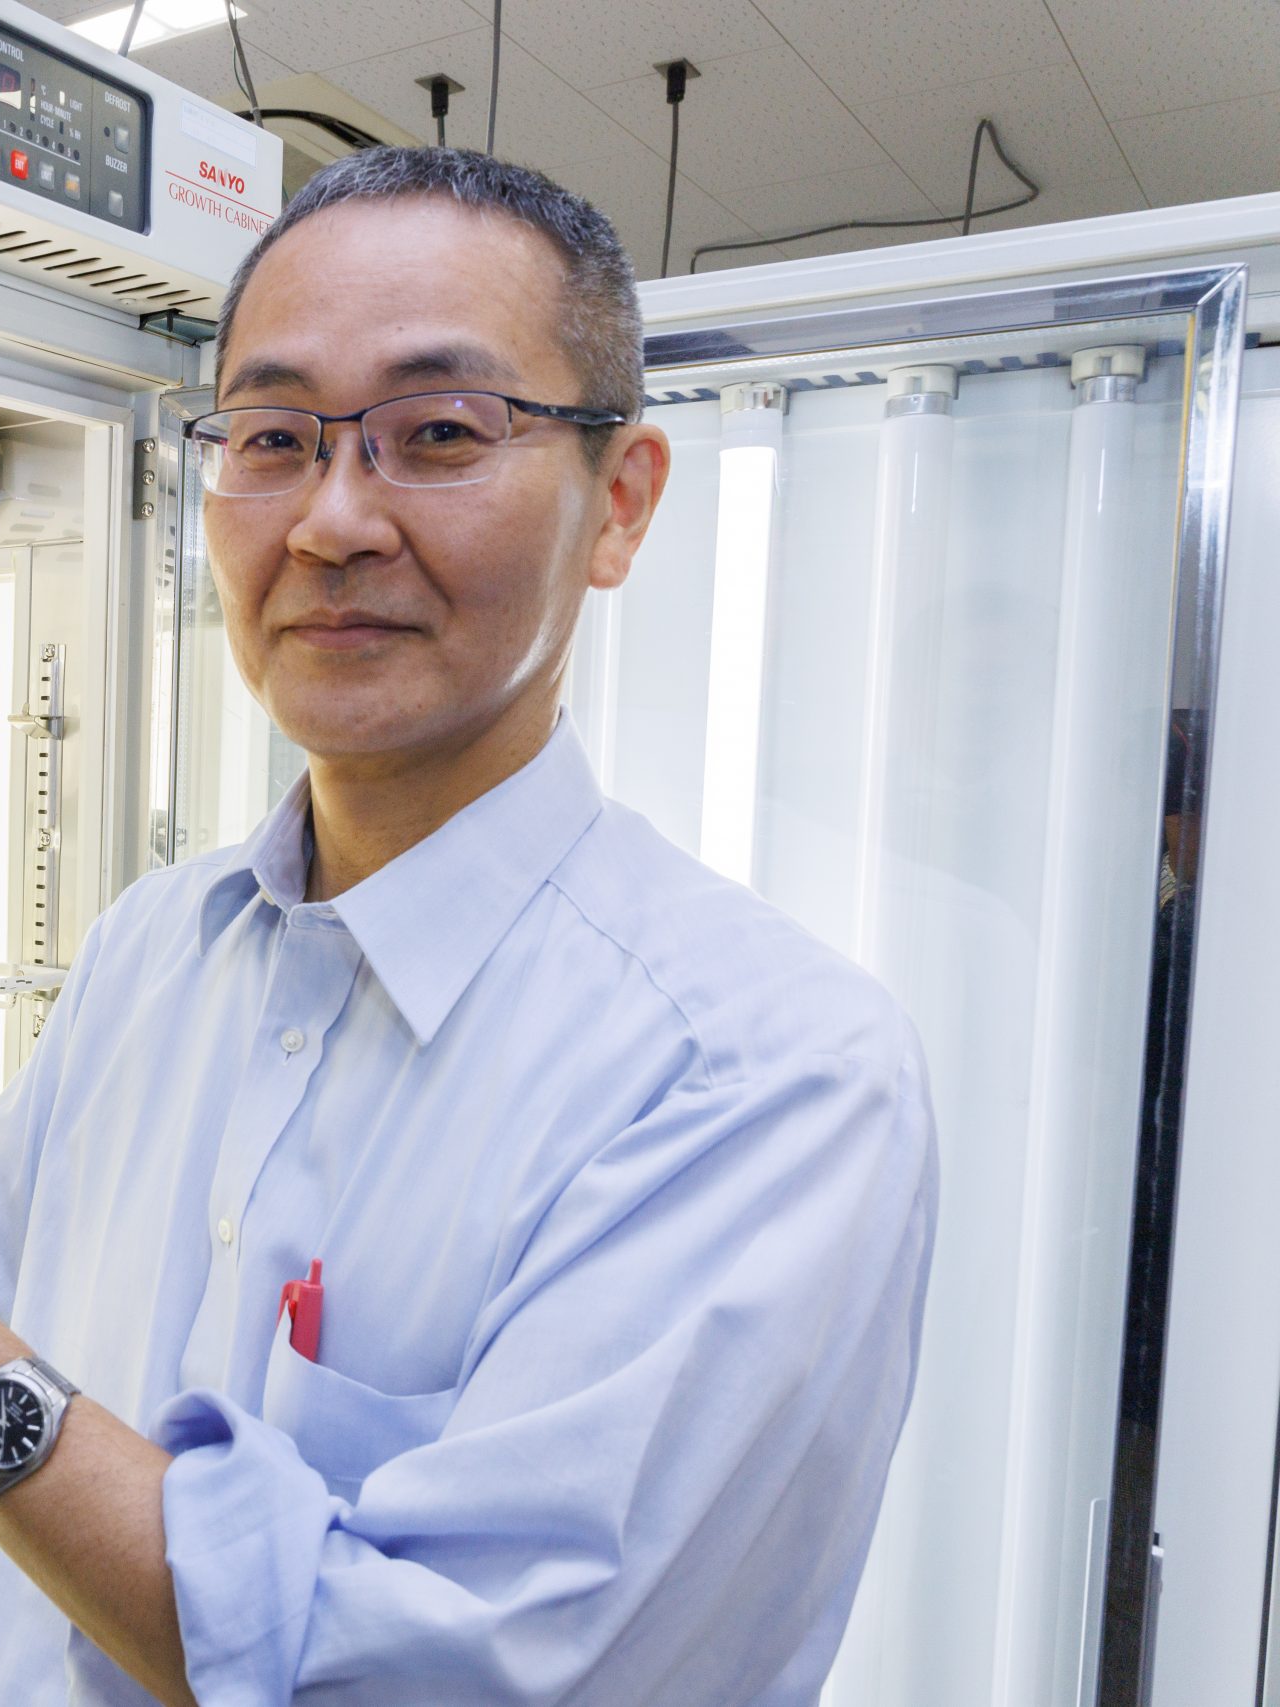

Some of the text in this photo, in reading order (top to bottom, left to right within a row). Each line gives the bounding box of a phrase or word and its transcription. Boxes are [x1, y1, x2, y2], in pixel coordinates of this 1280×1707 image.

[69, 99, 83, 113] LIGHT
[104, 91, 131, 113] DEFROST
[40, 115, 55, 129] CYCLE
[19, 127, 24, 137] 2
[35, 133, 40, 144] 3
[51, 140, 56, 150] 4
[105, 155, 128, 174] BUZZER
[199, 160, 245, 194] SANYO
[169, 182, 222, 218] GROWTH
